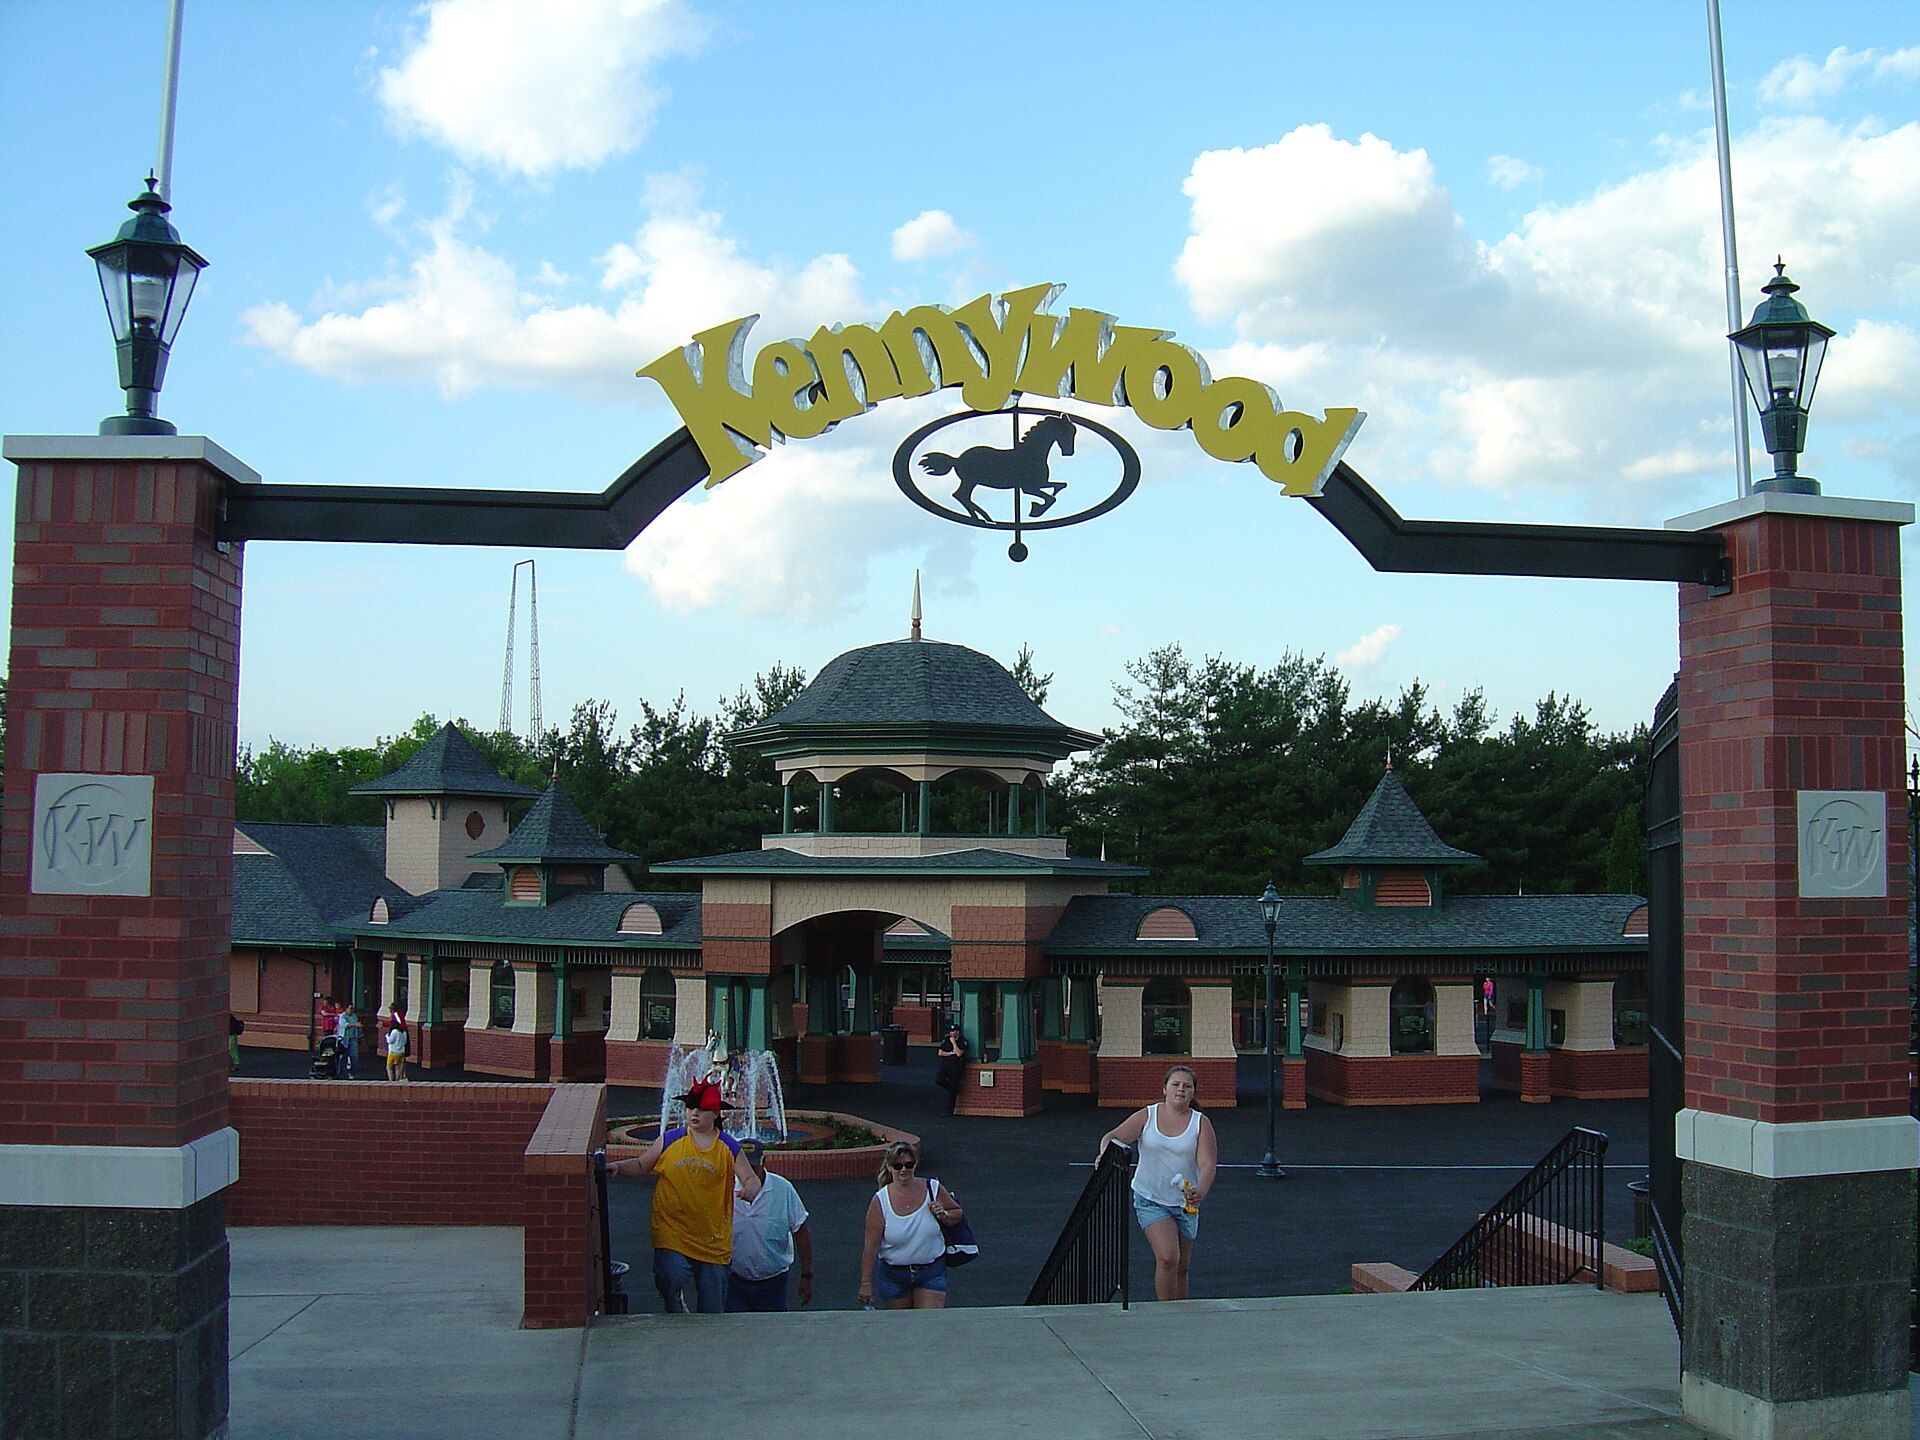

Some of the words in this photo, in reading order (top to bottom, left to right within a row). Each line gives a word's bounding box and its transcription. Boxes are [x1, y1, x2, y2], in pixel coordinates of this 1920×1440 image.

[635, 282, 1363, 498] Kennywood
[48, 803, 147, 870] KW
[1808, 817, 1882, 877] KW
